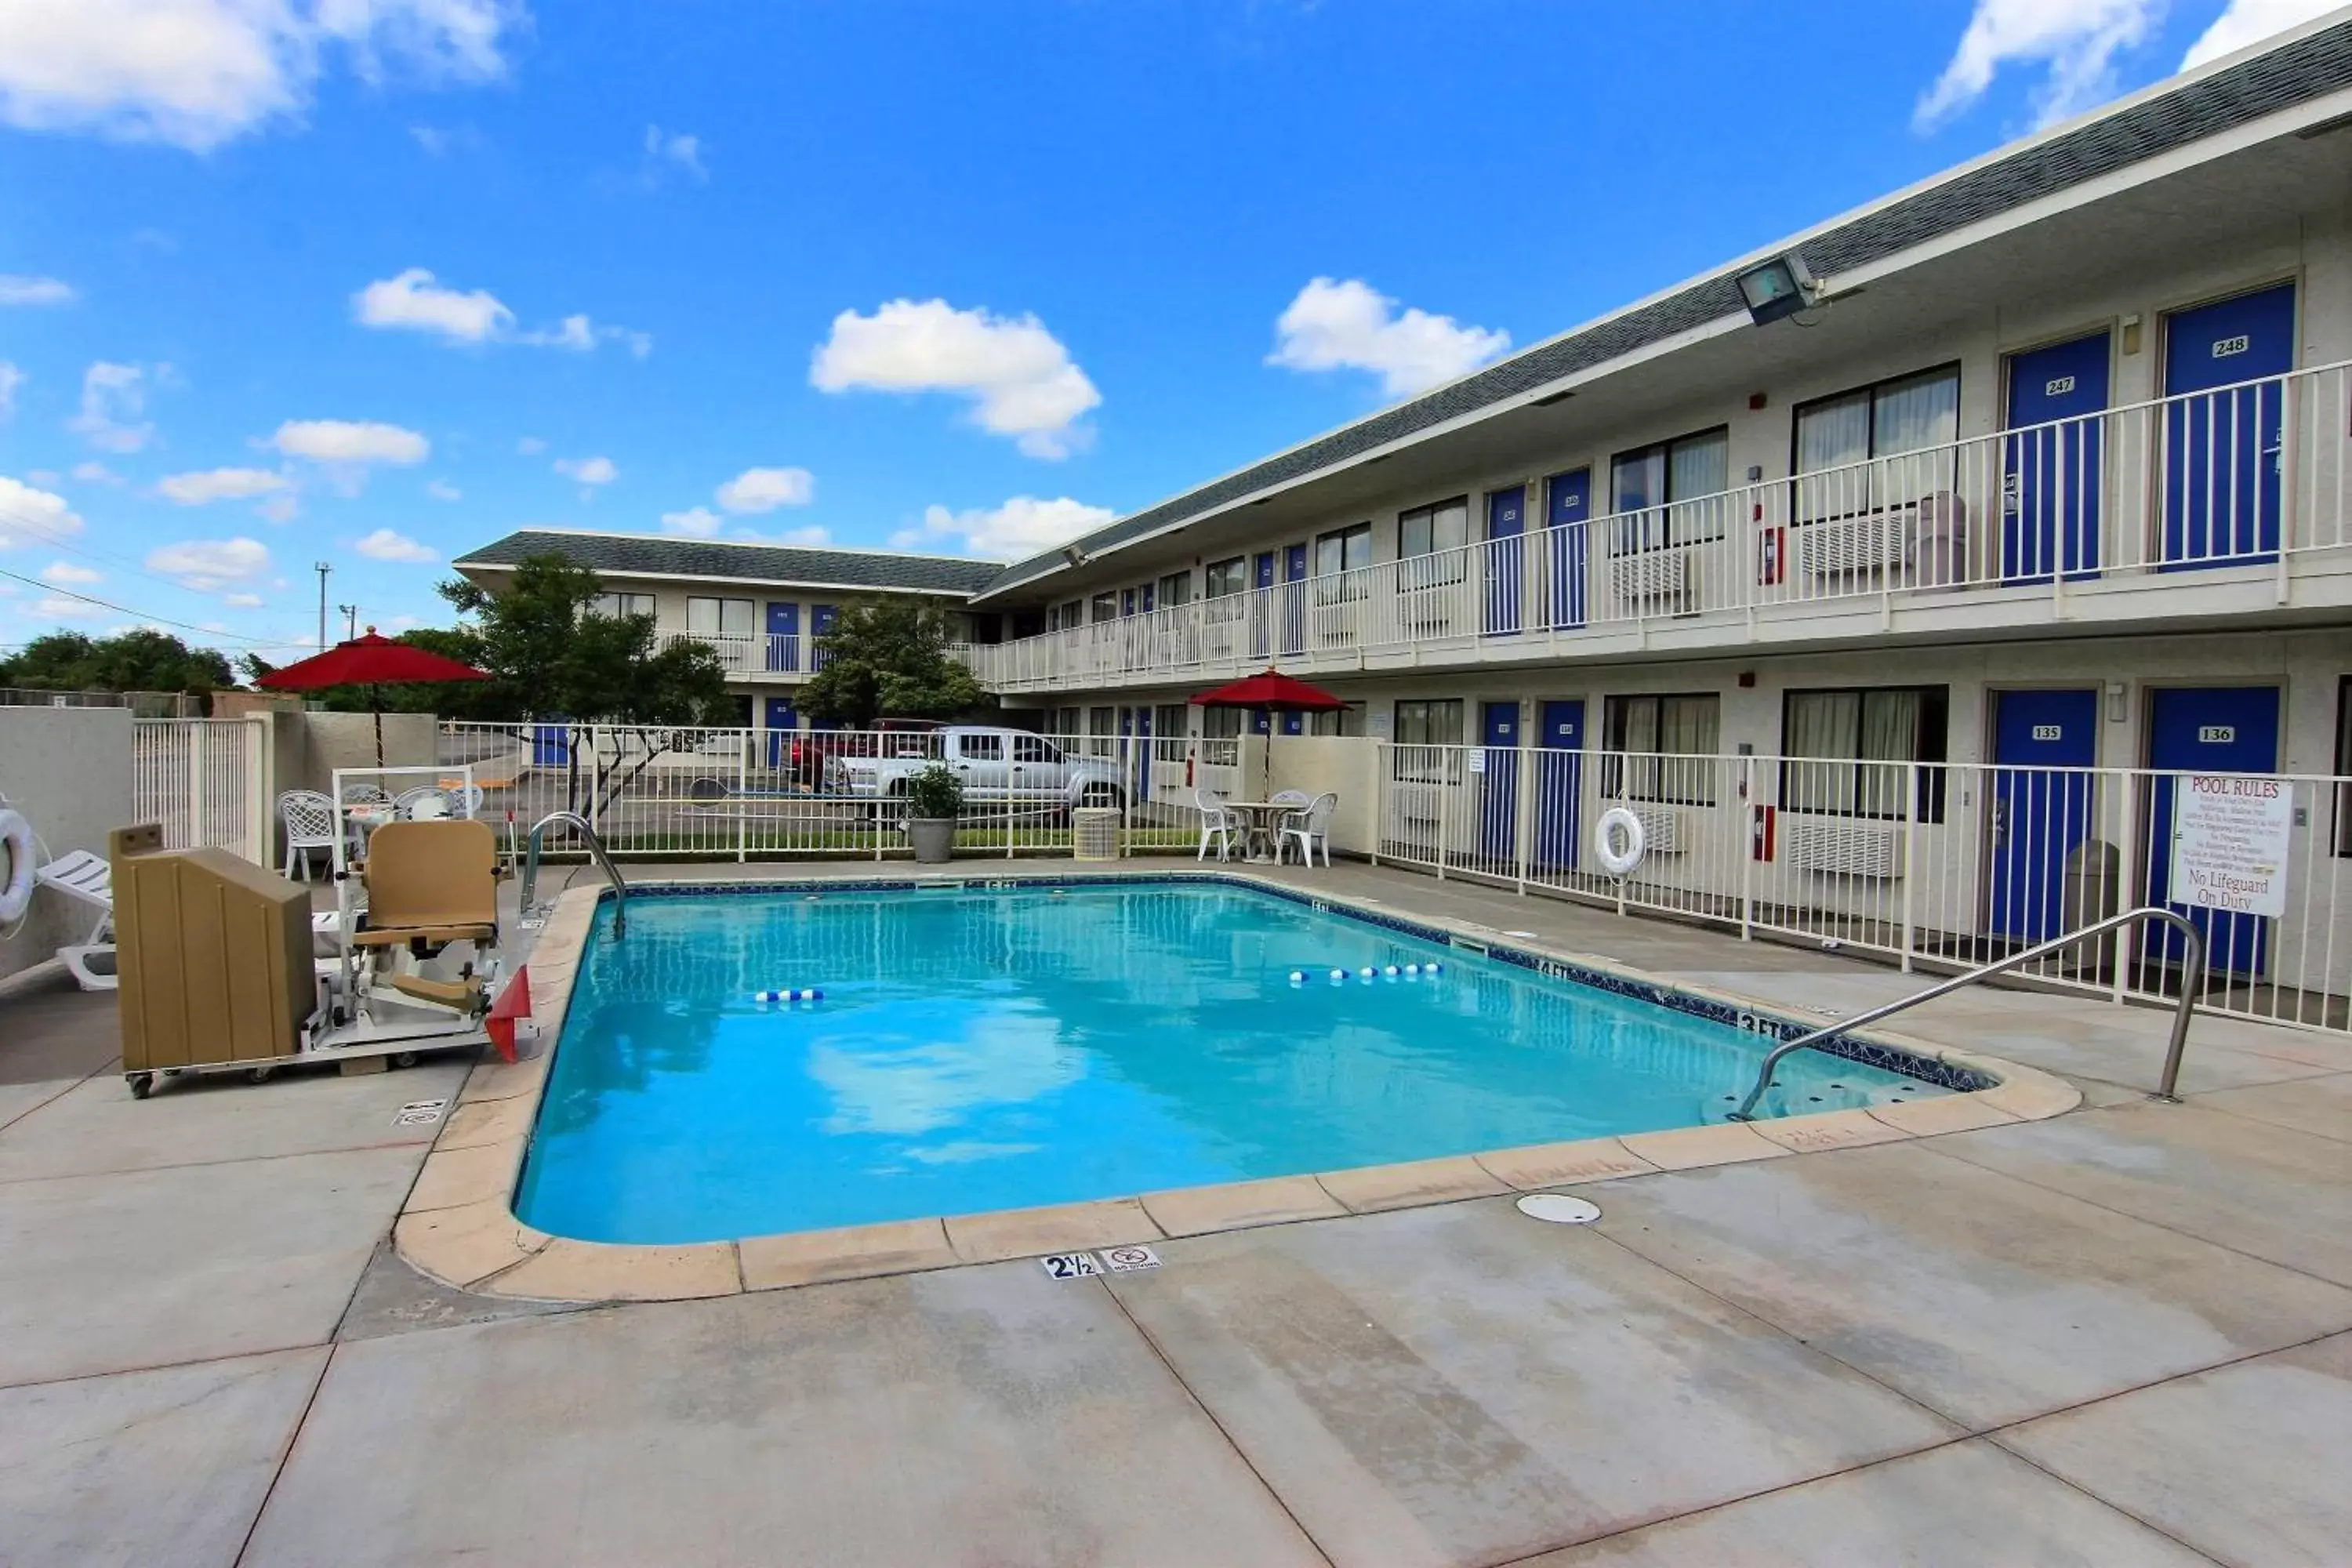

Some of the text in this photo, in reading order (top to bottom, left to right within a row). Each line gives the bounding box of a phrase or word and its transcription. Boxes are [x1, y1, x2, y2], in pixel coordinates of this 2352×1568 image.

[2216, 338, 2245, 355] 248
[2049, 379, 2071, 394] 247
[2036, 727, 2058, 738] 135
[2204, 728, 2230, 741] 136
[2192, 775, 2279, 799] POOL RULES
[2188, 868, 2269, 895] No Lifeguard
[2198, 888, 2253, 910] On Duty
[1759, 1018, 1779, 1039] FT
